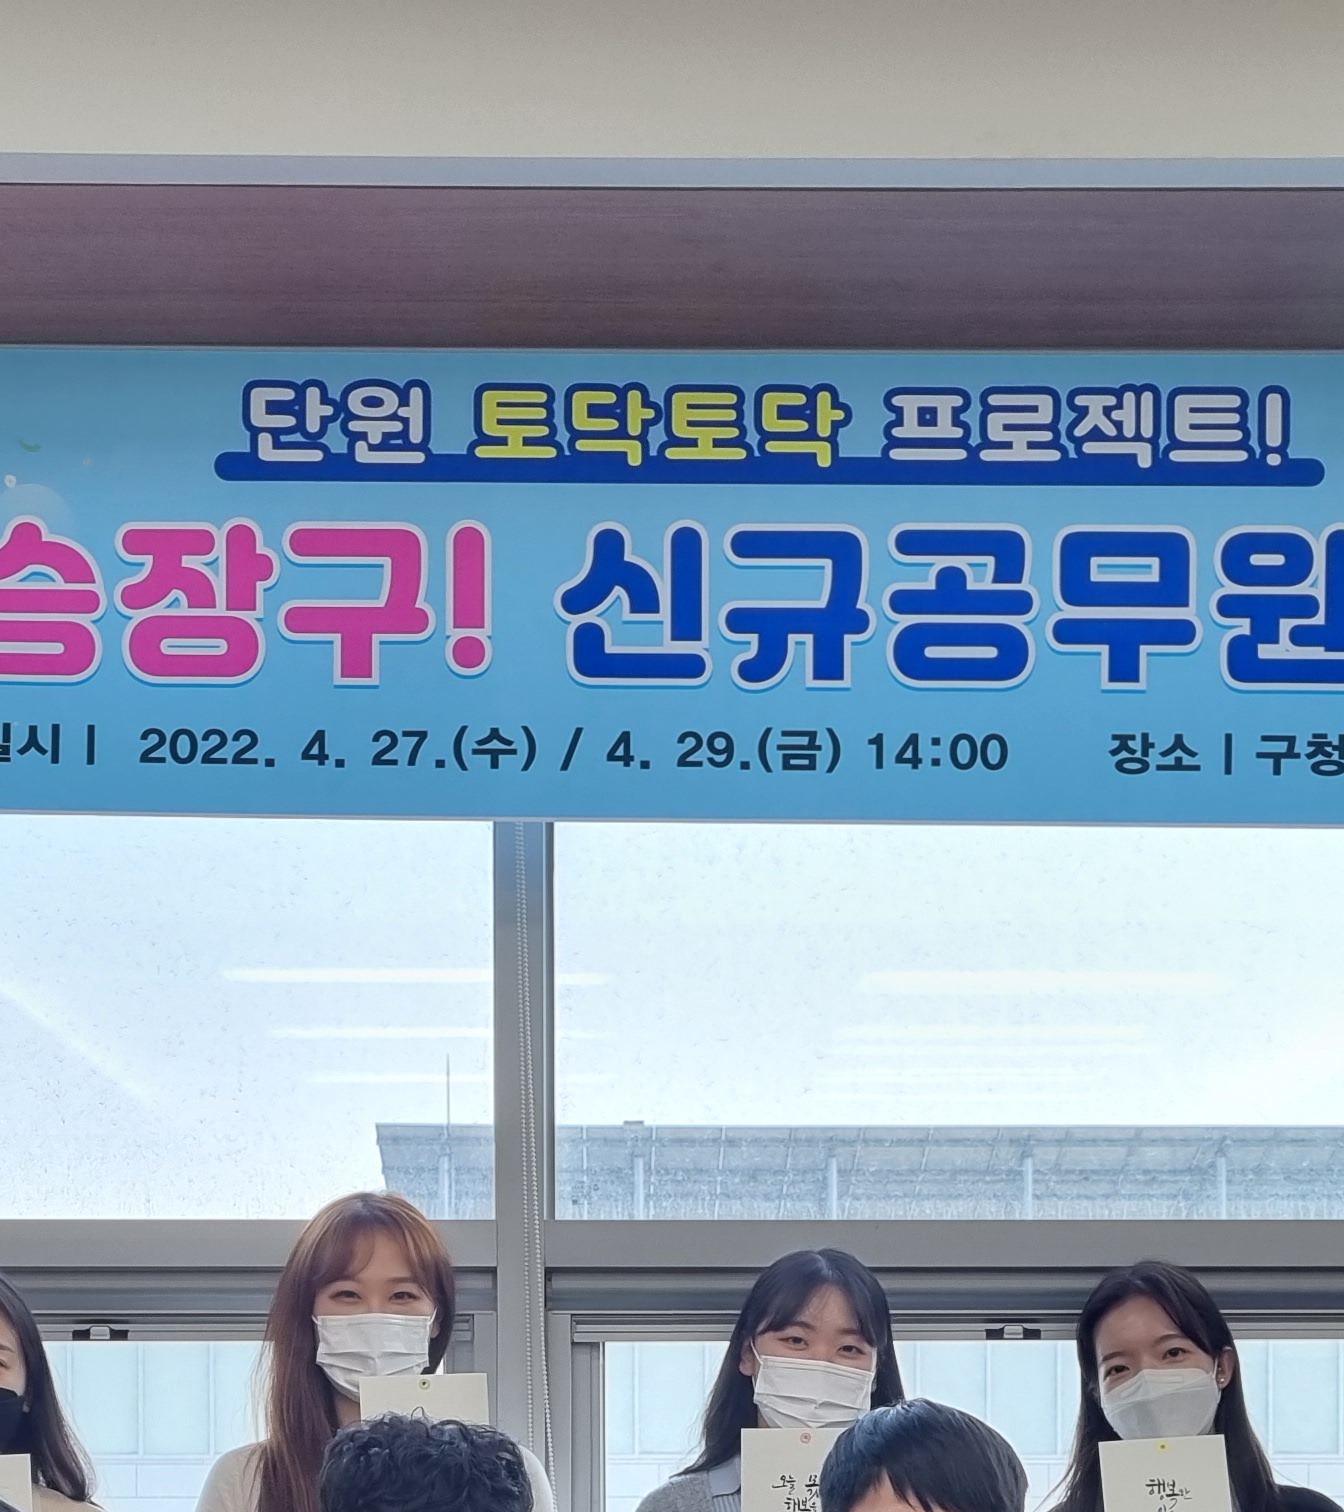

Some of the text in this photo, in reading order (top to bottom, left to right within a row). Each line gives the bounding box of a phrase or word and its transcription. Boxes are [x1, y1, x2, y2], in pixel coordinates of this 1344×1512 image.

[246, 383, 1284, 469] 단원 토닥토닥 프로젝트!
[138, 727, 276, 769] 2022.
[300, 729, 346, 769] 4.
[370, 725, 537, 772] 27.(수)
[605, 730, 652, 771] 4.
[675, 727, 841, 774] 29.(금)
[866, 732, 1010, 771] 14:00
[771, 1474, 797, 1496] 오늘
